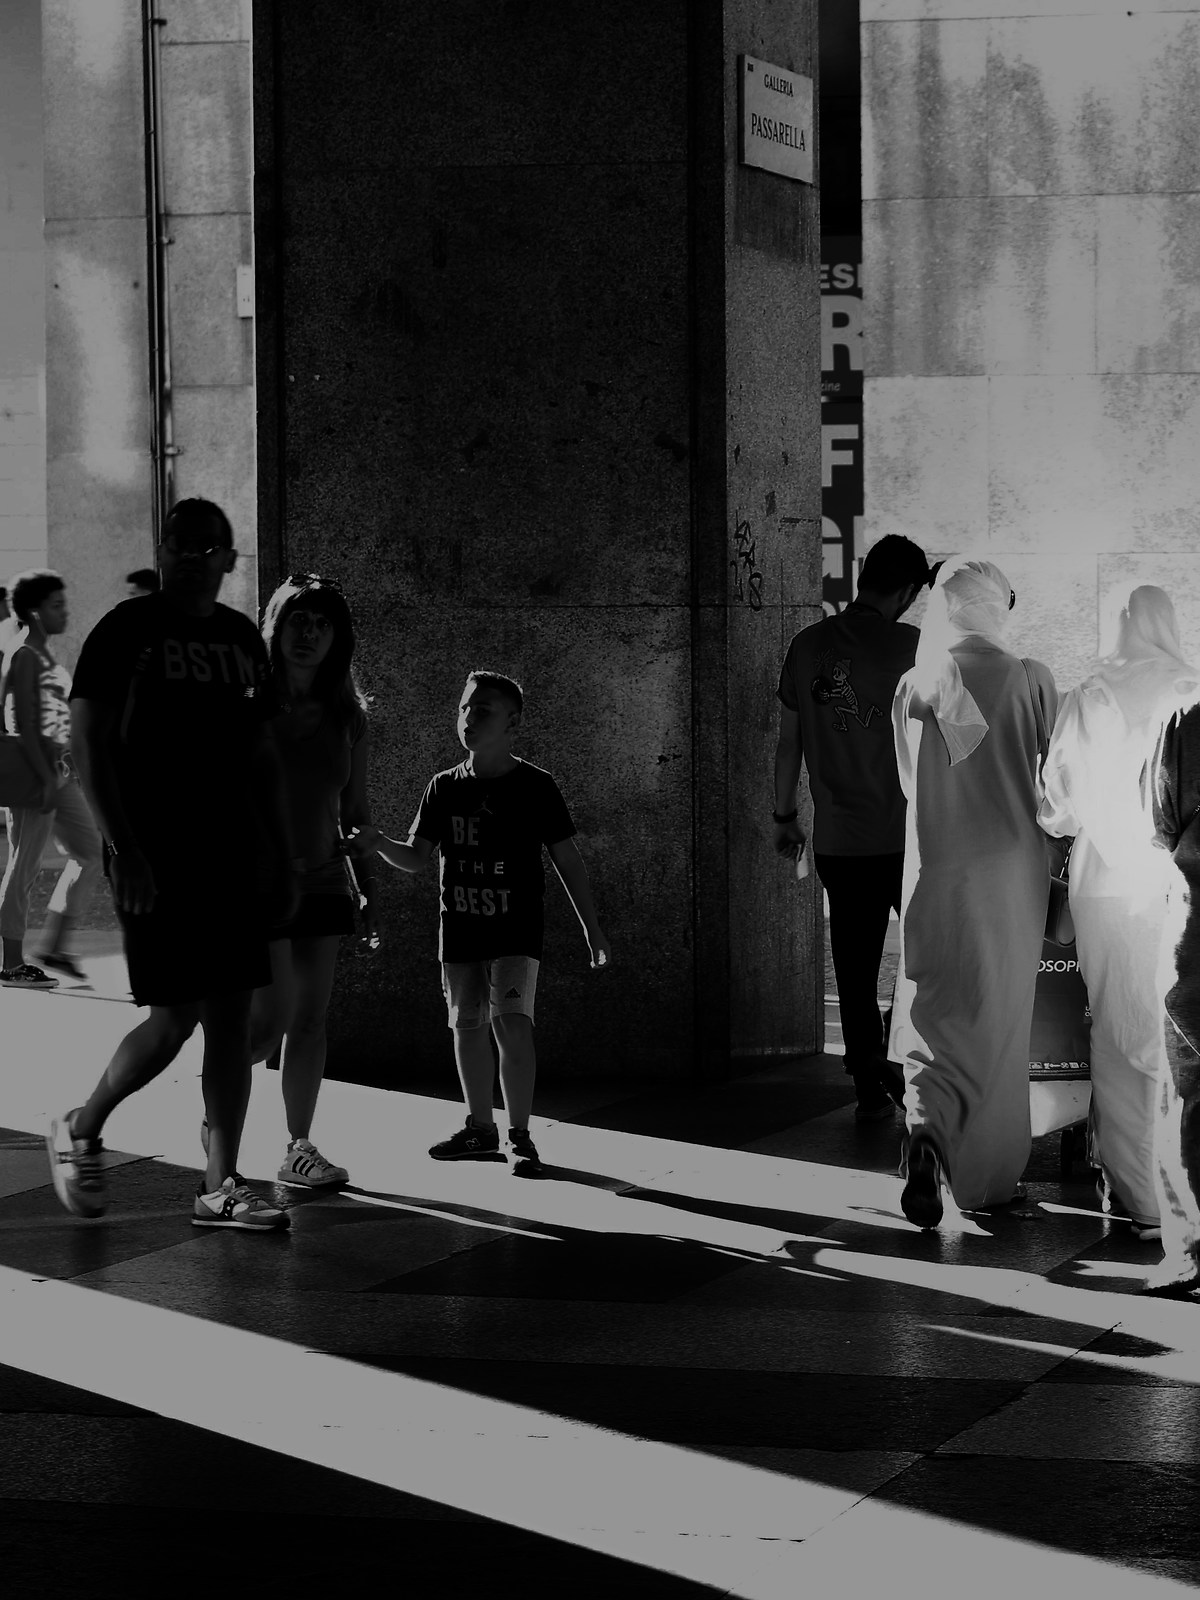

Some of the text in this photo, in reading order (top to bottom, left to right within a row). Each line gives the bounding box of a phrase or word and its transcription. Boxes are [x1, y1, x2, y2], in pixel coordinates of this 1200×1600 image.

[764, 74, 794, 97] GALLERIA
[752, 112, 806, 152] PASSARELLA
[163, 638, 256, 685] BSTN
[451, 815, 480, 846] BE
[458, 859, 504, 875] THE
[453, 885, 511, 917] BEST
